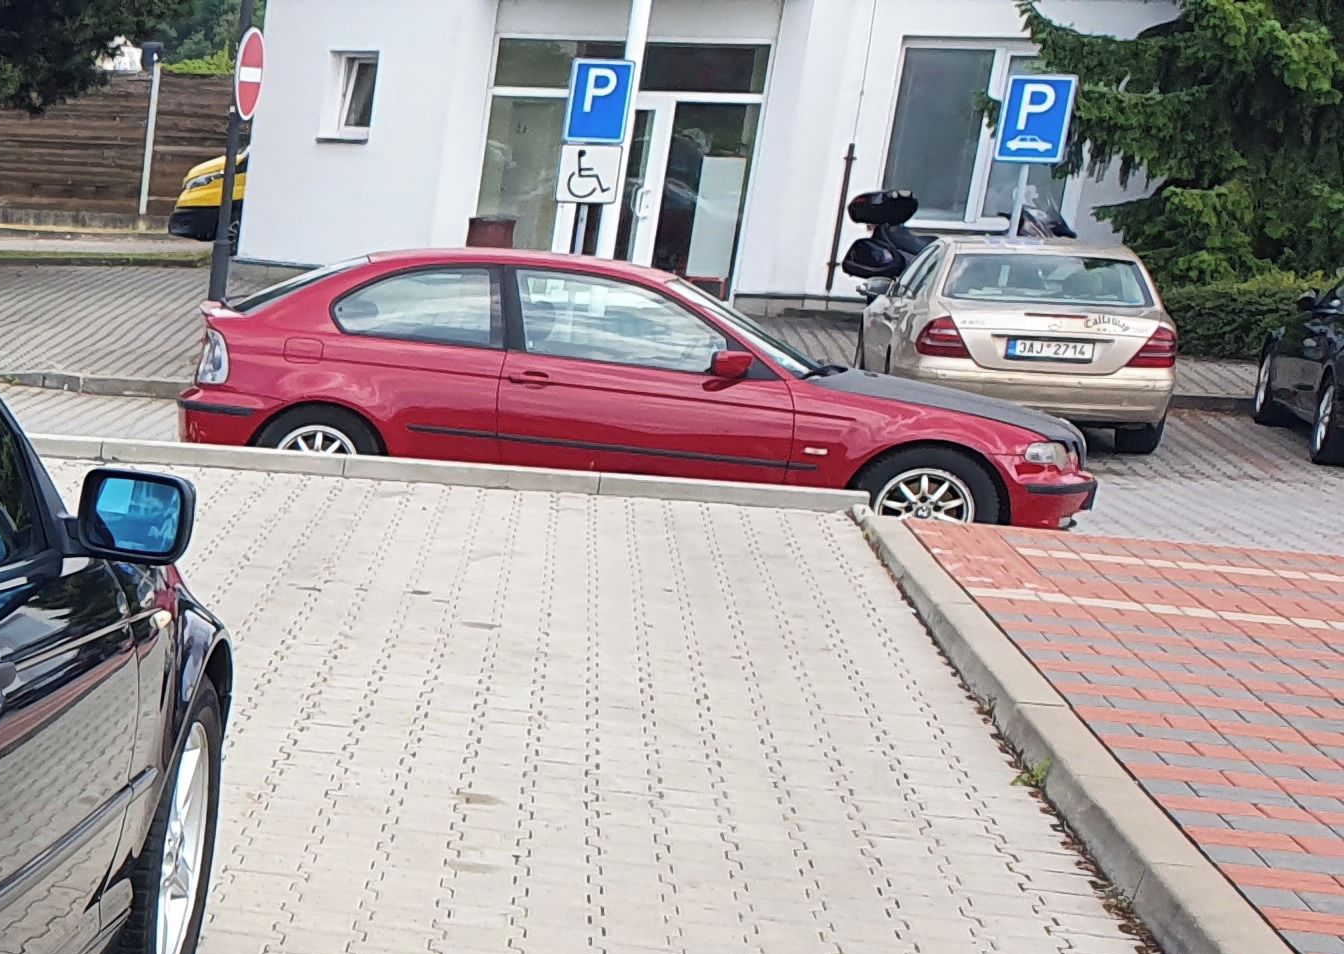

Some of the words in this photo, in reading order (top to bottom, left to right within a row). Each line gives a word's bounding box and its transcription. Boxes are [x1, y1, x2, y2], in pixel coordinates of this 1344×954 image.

[583, 67, 617, 112] P
[1016, 83, 1056, 130] P
[1053, 343, 1086, 356] 2714
